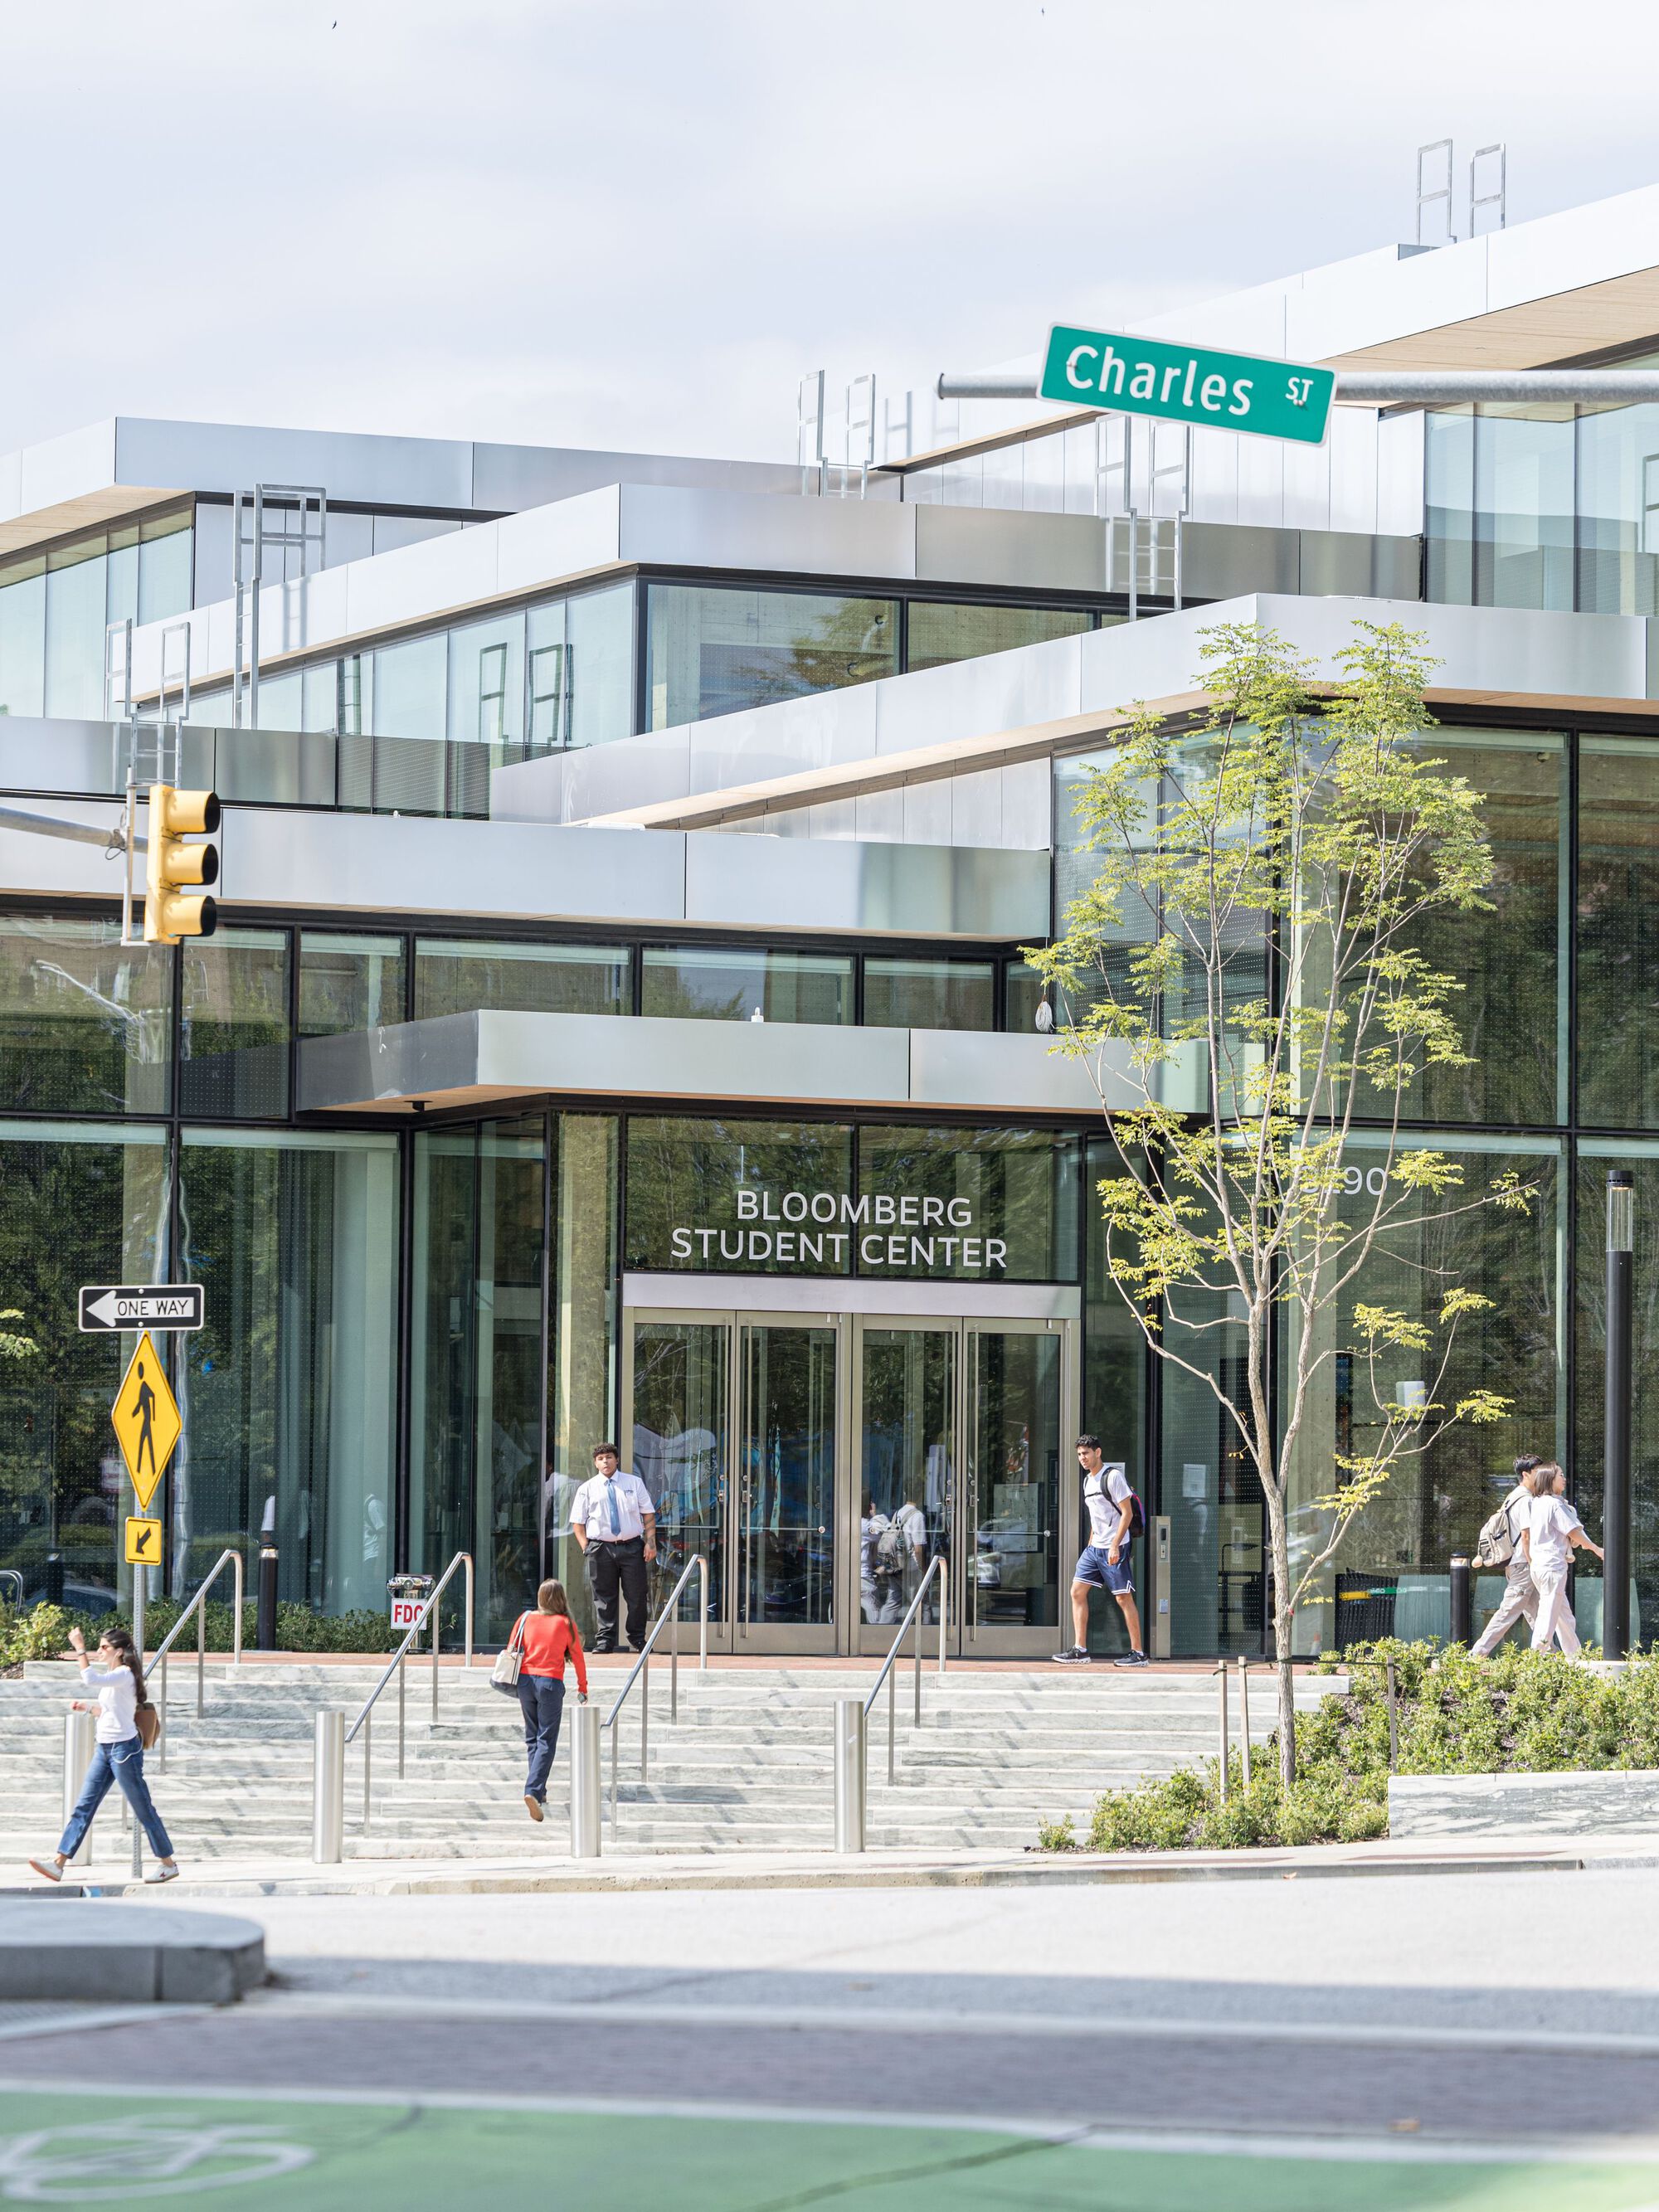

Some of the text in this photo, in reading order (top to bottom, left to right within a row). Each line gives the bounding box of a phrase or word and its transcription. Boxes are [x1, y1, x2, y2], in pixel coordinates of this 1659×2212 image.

[1066, 345, 1315, 416] Charles ST
[1300, 1165, 1388, 1196] 90
[737, 1190, 972, 1228] BLOOMBERG
[671, 1228, 1008, 1268] STUDENT CENTER
[118, 1299, 188, 1315] ONE WAY
